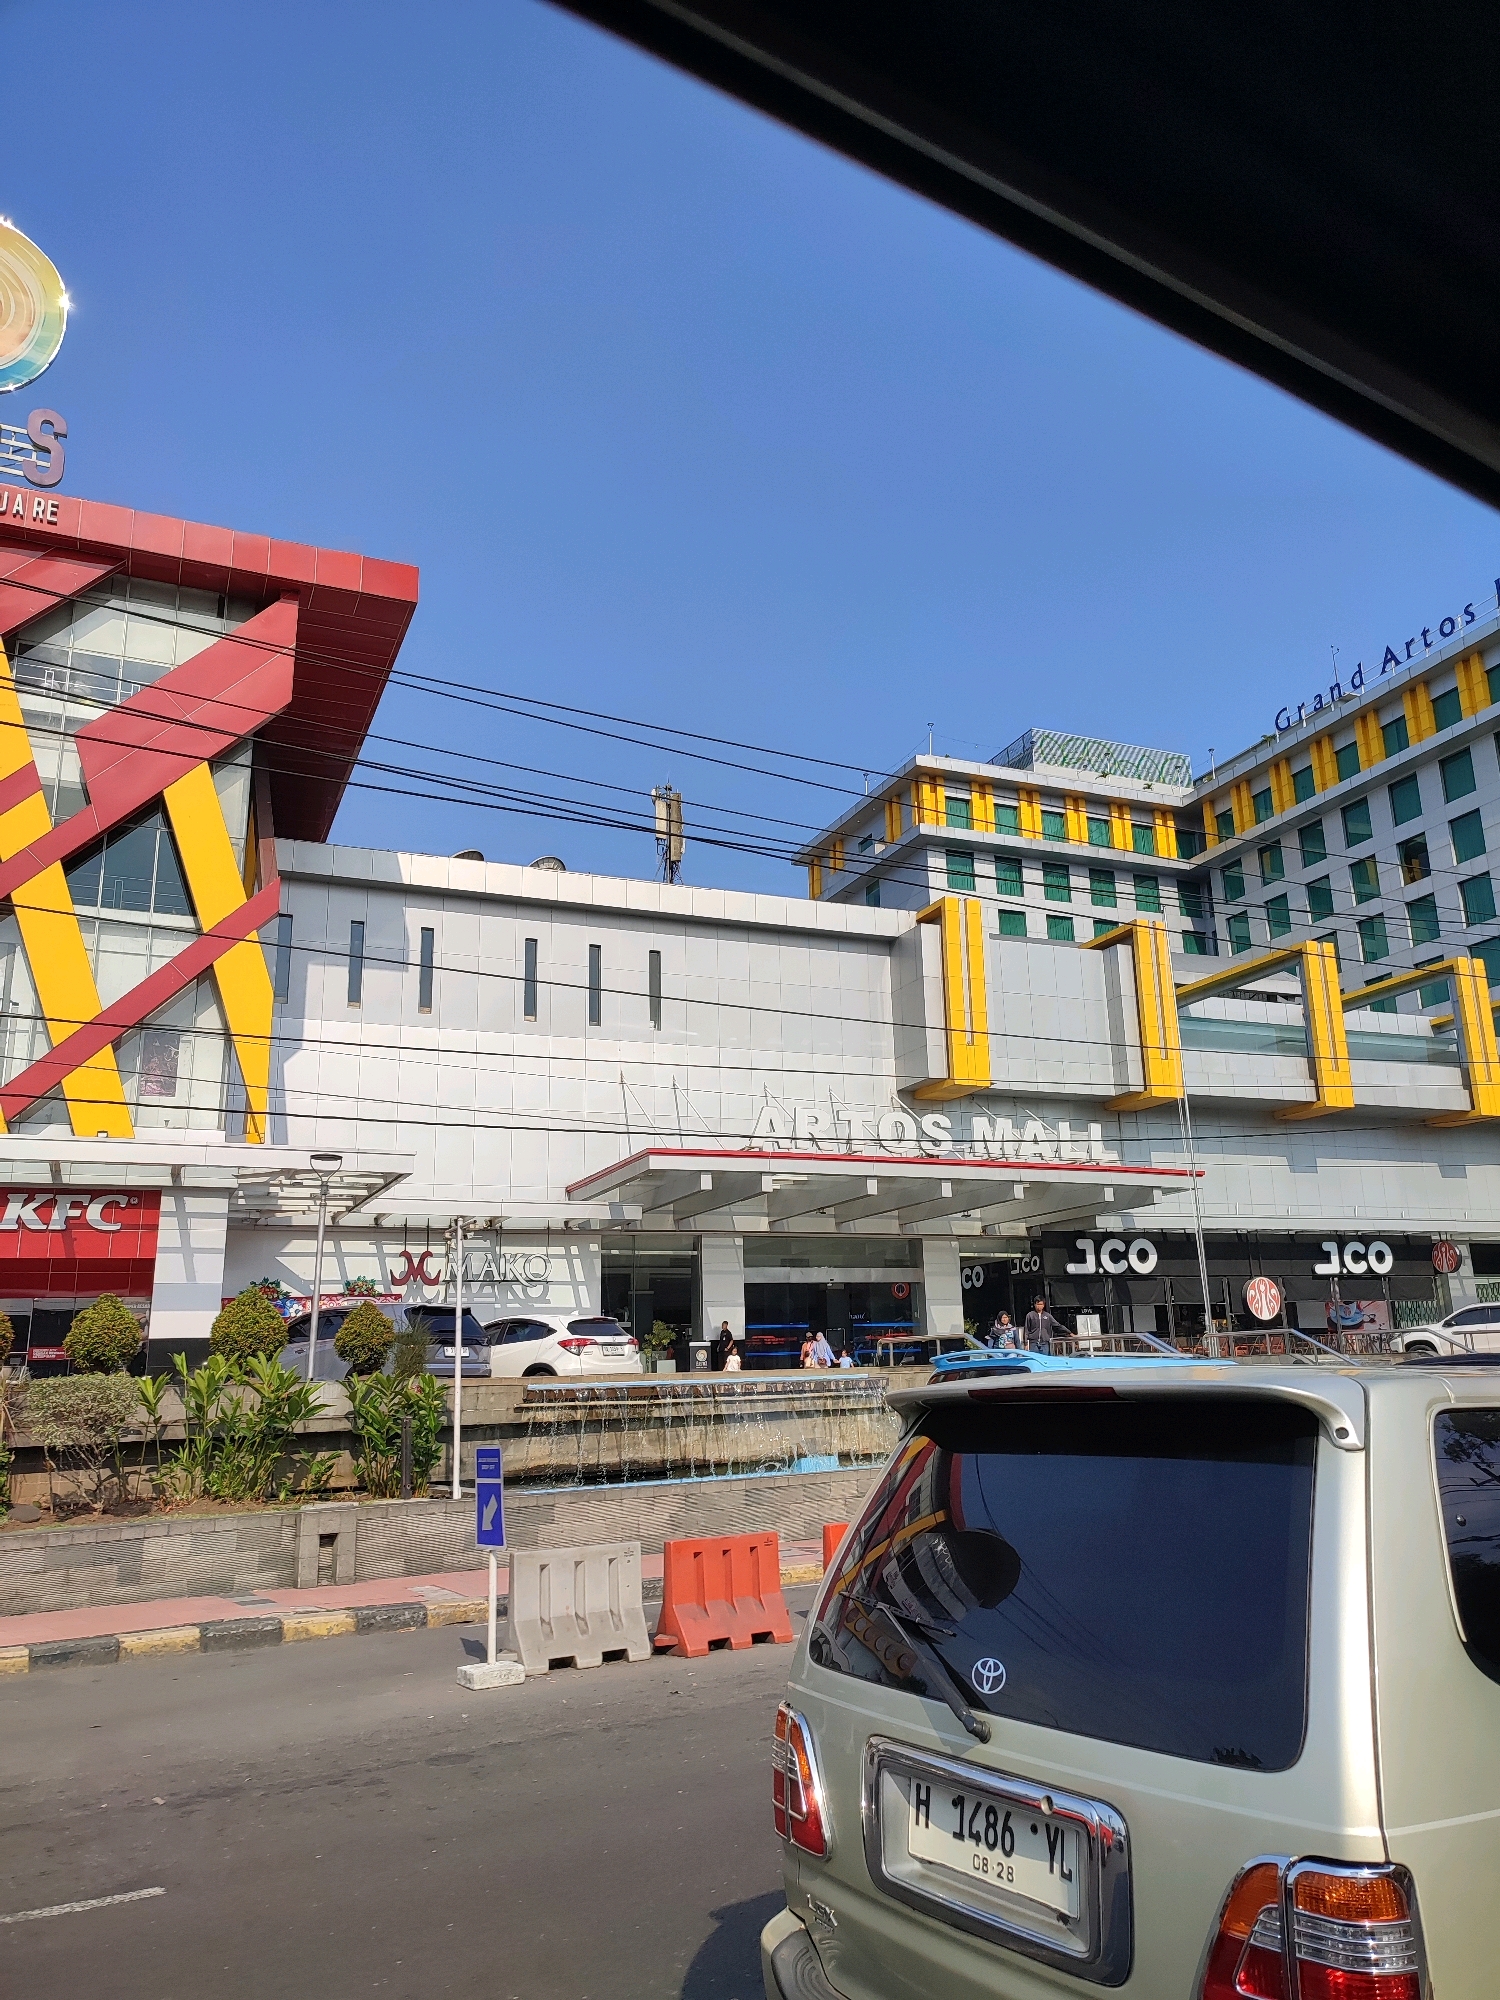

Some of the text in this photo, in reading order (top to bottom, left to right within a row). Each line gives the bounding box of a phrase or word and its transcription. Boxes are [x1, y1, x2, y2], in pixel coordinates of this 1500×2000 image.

[1275, 602, 1476, 732] Grand Artos
[750, 1105, 1121, 1165] ARTOS MALL
[0, 1193, 128, 1231] KFC
[445, 1252, 553, 1288] MAKO
[1011, 1256, 1040, 1275] J.CO
[1066, 1238, 1158, 1274] J.CO
[1313, 1240, 1394, 1275] J.CO
[915, 1782, 1072, 1883] H 1486 YL
